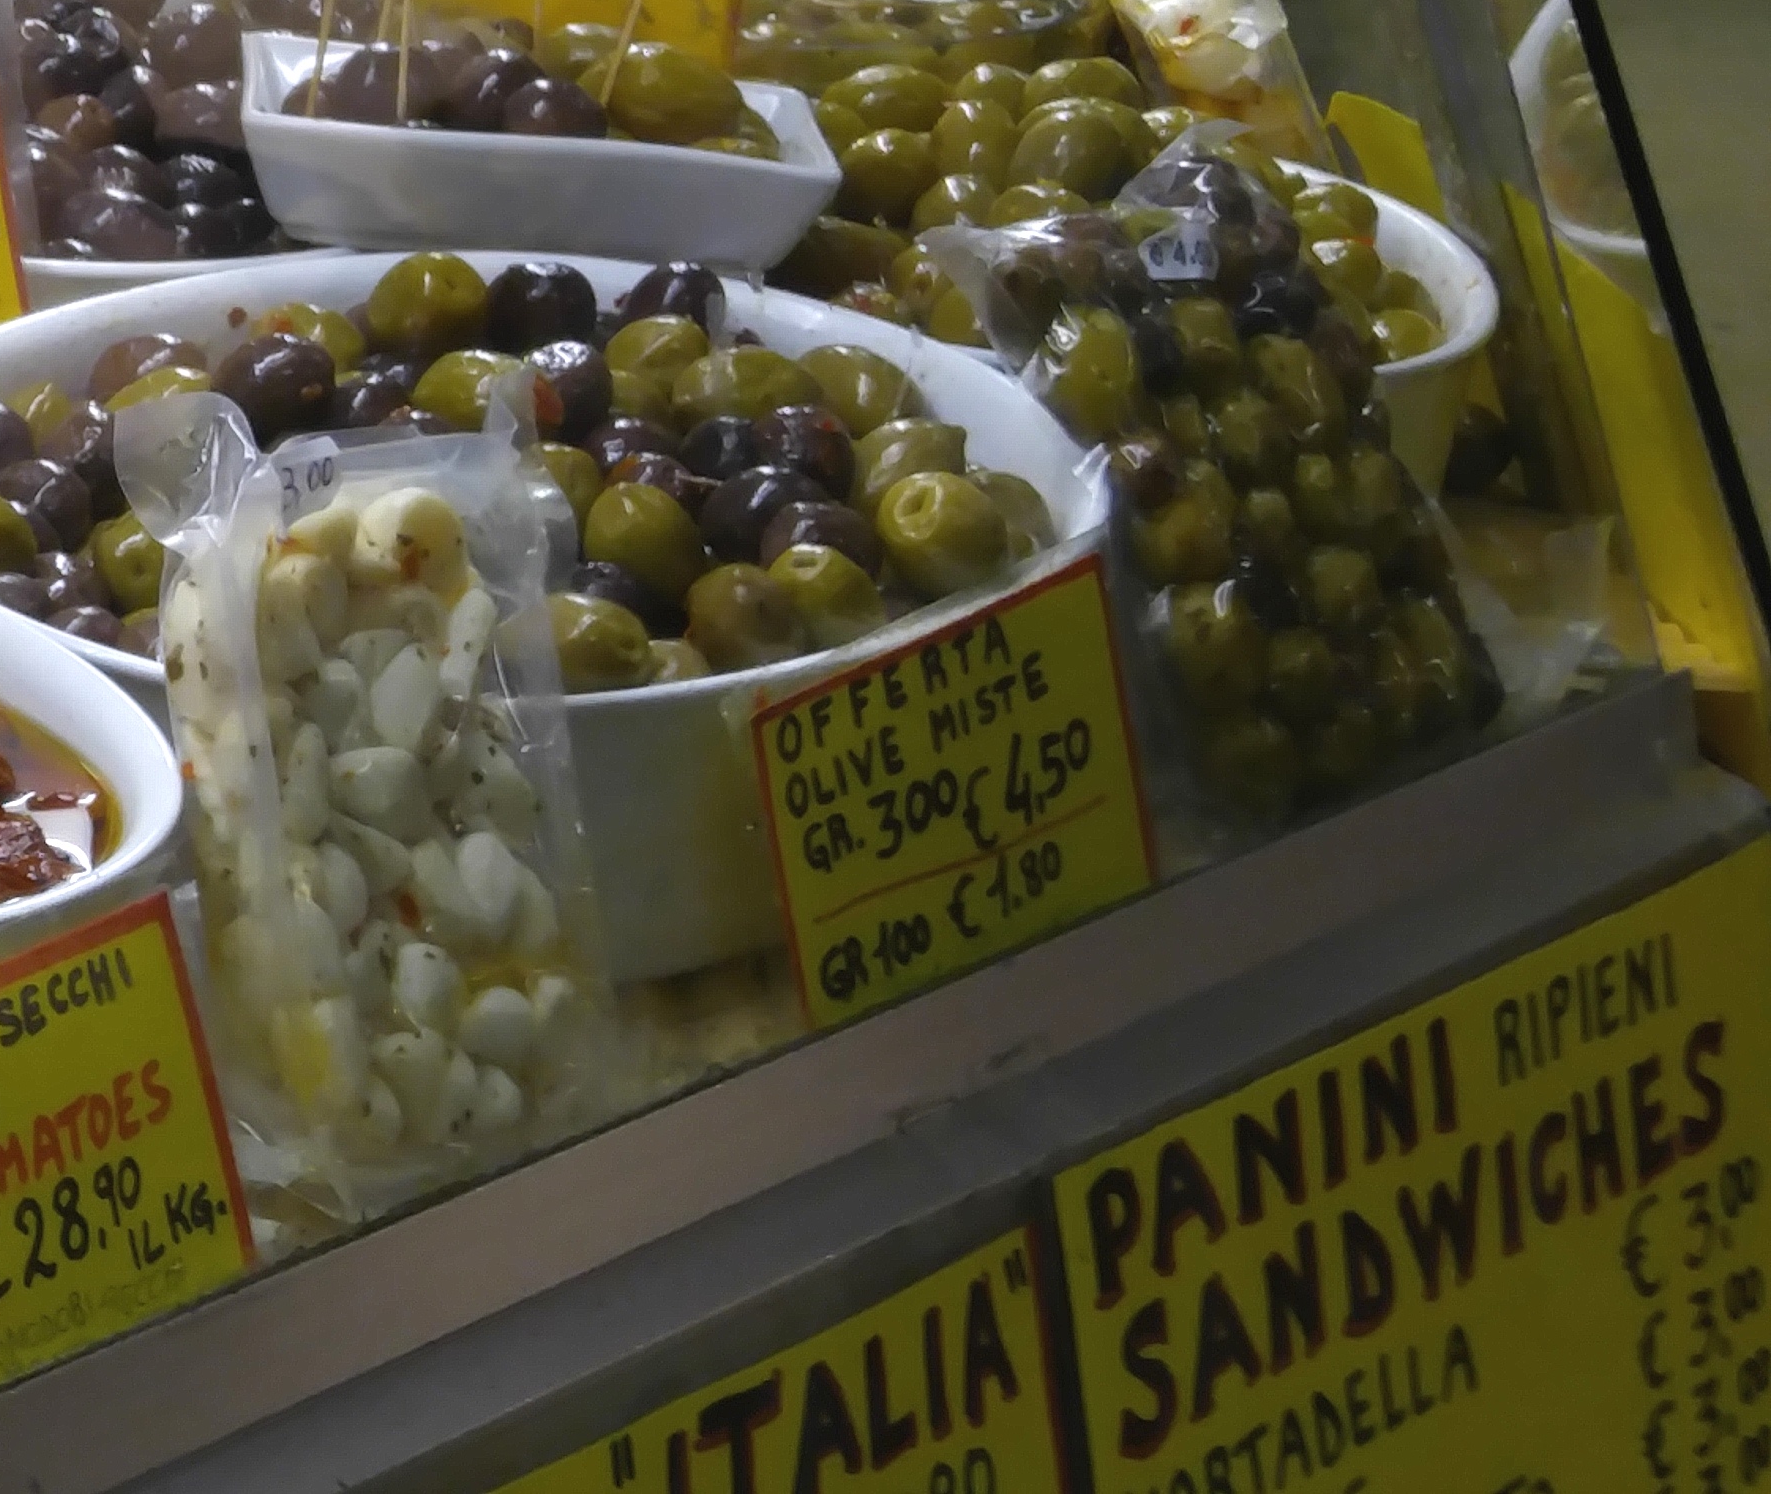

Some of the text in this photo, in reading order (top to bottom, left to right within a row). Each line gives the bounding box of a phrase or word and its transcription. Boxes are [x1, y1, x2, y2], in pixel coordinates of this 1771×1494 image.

[776, 617, 1011, 763] OFFERTA
[784, 650, 1050, 819] OLIVE MISTE
[1086, 932, 1679, 1311] PANINI RIPIENI
[128, 1227, 165, 1271] IL
[1119, 1019, 1727, 1462] SANDWICHES
[1127, 1323, 1480, 1494] RTADELLA
